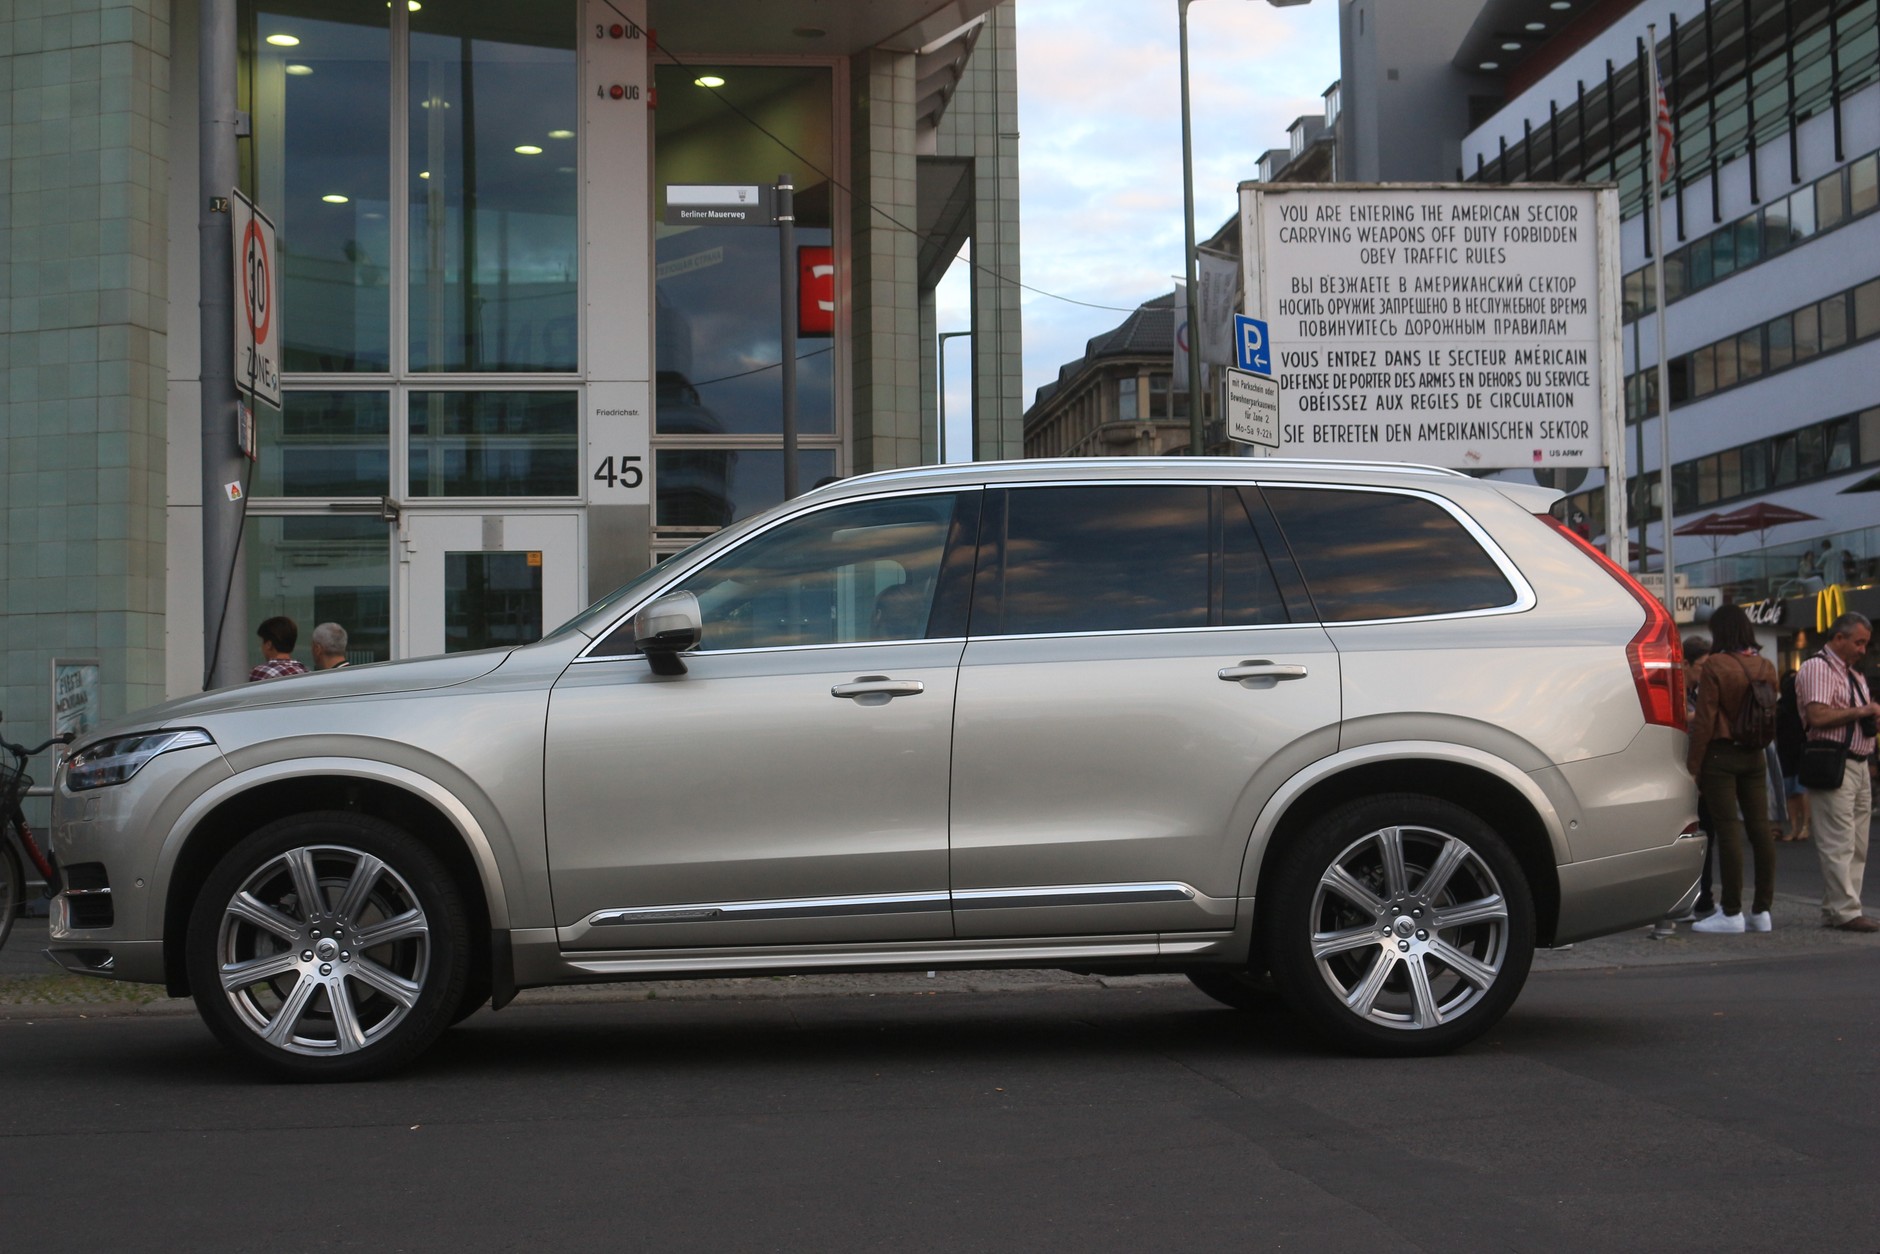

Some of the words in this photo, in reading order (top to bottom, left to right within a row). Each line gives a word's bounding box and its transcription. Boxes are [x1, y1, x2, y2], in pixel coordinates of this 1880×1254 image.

[595, 24, 604, 39] 3
[625, 25, 640, 39] UG
[597, 85, 604, 100] 4
[624, 85, 640, 100] UG
[680, 210, 707, 218] Berliner
[707, 210, 746, 220] Mauerweg
[1279, 205, 1308, 222] YOU
[1315, 205, 1342, 222] ARE
[1350, 205, 1415, 222] ENTERING
[1421, 205, 1443, 222] THE
[1451, 205, 1520, 222] AMERICAN
[1527, 205, 1578, 222] SECTOR
[1279, 226, 1352, 243] CARRYING
[1357, 226, 1425, 243] WEAPONS
[1431, 226, 1456, 243] OFF
[1464, 226, 1497, 243] DUTY
[1503, 226, 1577, 243] FORBIDDEN
[1360, 248, 1397, 264] OBEY
[1404, 247, 1458, 264] TRAFFIC
[1466, 247, 1506, 264] RULES
[1291, 277, 1313, 294] ВЫ
[1399, 276, 1407, 293] В
[1414, 274, 1523, 293] АМЕРИКАНСКИЙ
[1529, 276, 1576, 293] СЕКТОР
[1279, 298, 1324, 315] НОСИТЬ
[1328, 298, 1376, 315] ОРУЖИЕ
[1453, 297, 1461, 314] В
[1466, 297, 1546, 314] НЕСЛУЖЕБНОЕ
[1550, 298, 1587, 314] ВРЕМЯ
[1404, 318, 1486, 336] ДОРОЖНЫМ
[1494, 318, 1567, 335] ПРАВИЛАМ
[1243, 323, 1262, 364] P
[1281, 351, 1319, 368] VOUS
[1327, 350, 1376, 367] ENTREZ
[1385, 350, 1421, 367] DANS
[1429, 350, 1441, 366] LE
[1448, 349, 1506, 366] SECTEUR
[1514, 344, 1587, 366] AMÉRICAIN
[246, 346, 271, 388] ZONE
[1232, 378, 1240, 388] mit
[1241, 380, 1264, 394] Parkschein
[1265, 387, 1275, 396] oder
[1280, 373, 1329, 390] DEFENSE
[1333, 373, 1347, 389] DE
[1350, 372, 1391, 389] PORTER
[1394, 372, 1415, 388] DES
[1418, 371, 1455, 388] ARMES
[1459, 371, 1474, 388] EN
[1478, 371, 1522, 388] DEHORS
[1526, 371, 1541, 387] DU
[1545, 370, 1590, 387] SERVICE
[1298, 391, 1367, 412] OBÉISSEZ
[1376, 394, 1403, 411] AUX
[1410, 393, 1459, 410] REGLES
[1467, 393, 1482, 409] DE
[1490, 392, 1574, 408] CIRCULATION
[596, 408, 640, 416] Friedrichstr.
[1253, 412, 1263, 423] Zone
[1265, 414, 1270, 424] 2
[1235, 422, 1254, 436] Mo-Sa
[1284, 424, 1305, 443] SIE
[1313, 424, 1379, 443] BETRETEN
[1386, 423, 1411, 442] DEN
[1418, 421, 1533, 441] AMERIKANISCHEN
[1539, 420, 1589, 439] SEKTOR
[594, 456, 643, 488] 45
